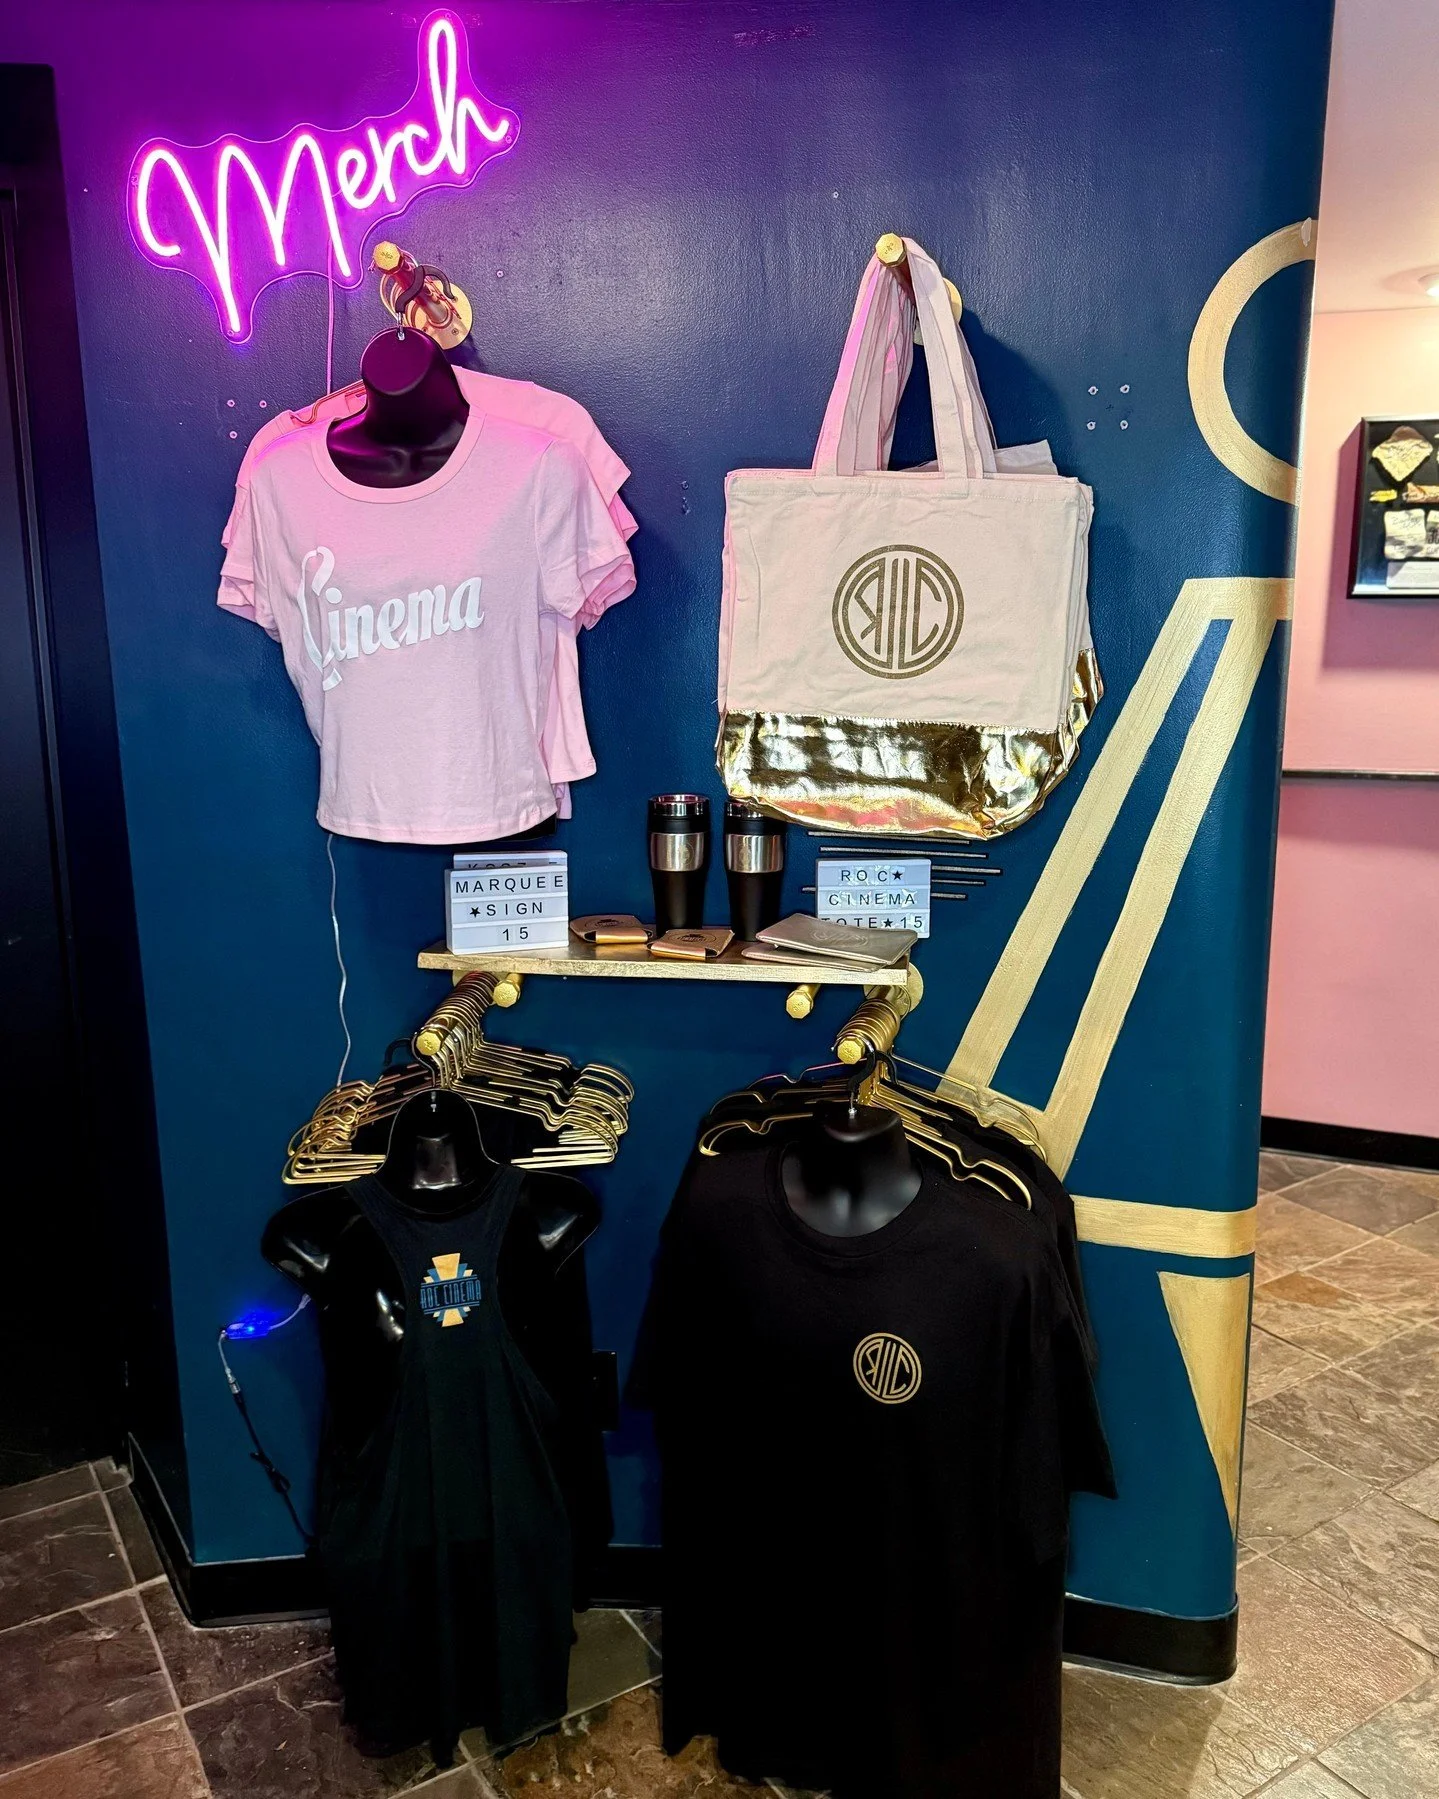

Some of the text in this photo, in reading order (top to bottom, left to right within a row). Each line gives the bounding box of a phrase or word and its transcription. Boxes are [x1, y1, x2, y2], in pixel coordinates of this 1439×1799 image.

[136, 19, 510, 333] Merch
[297, 546, 485, 691] Cinema
[841, 870, 888, 882] ROC
[455, 875, 564, 893] MARQUEE
[828, 893, 916, 906] CINEMA
[486, 902, 543, 917] SIGN
[900, 916, 923, 929] 15
[502, 926, 529, 941] 15
